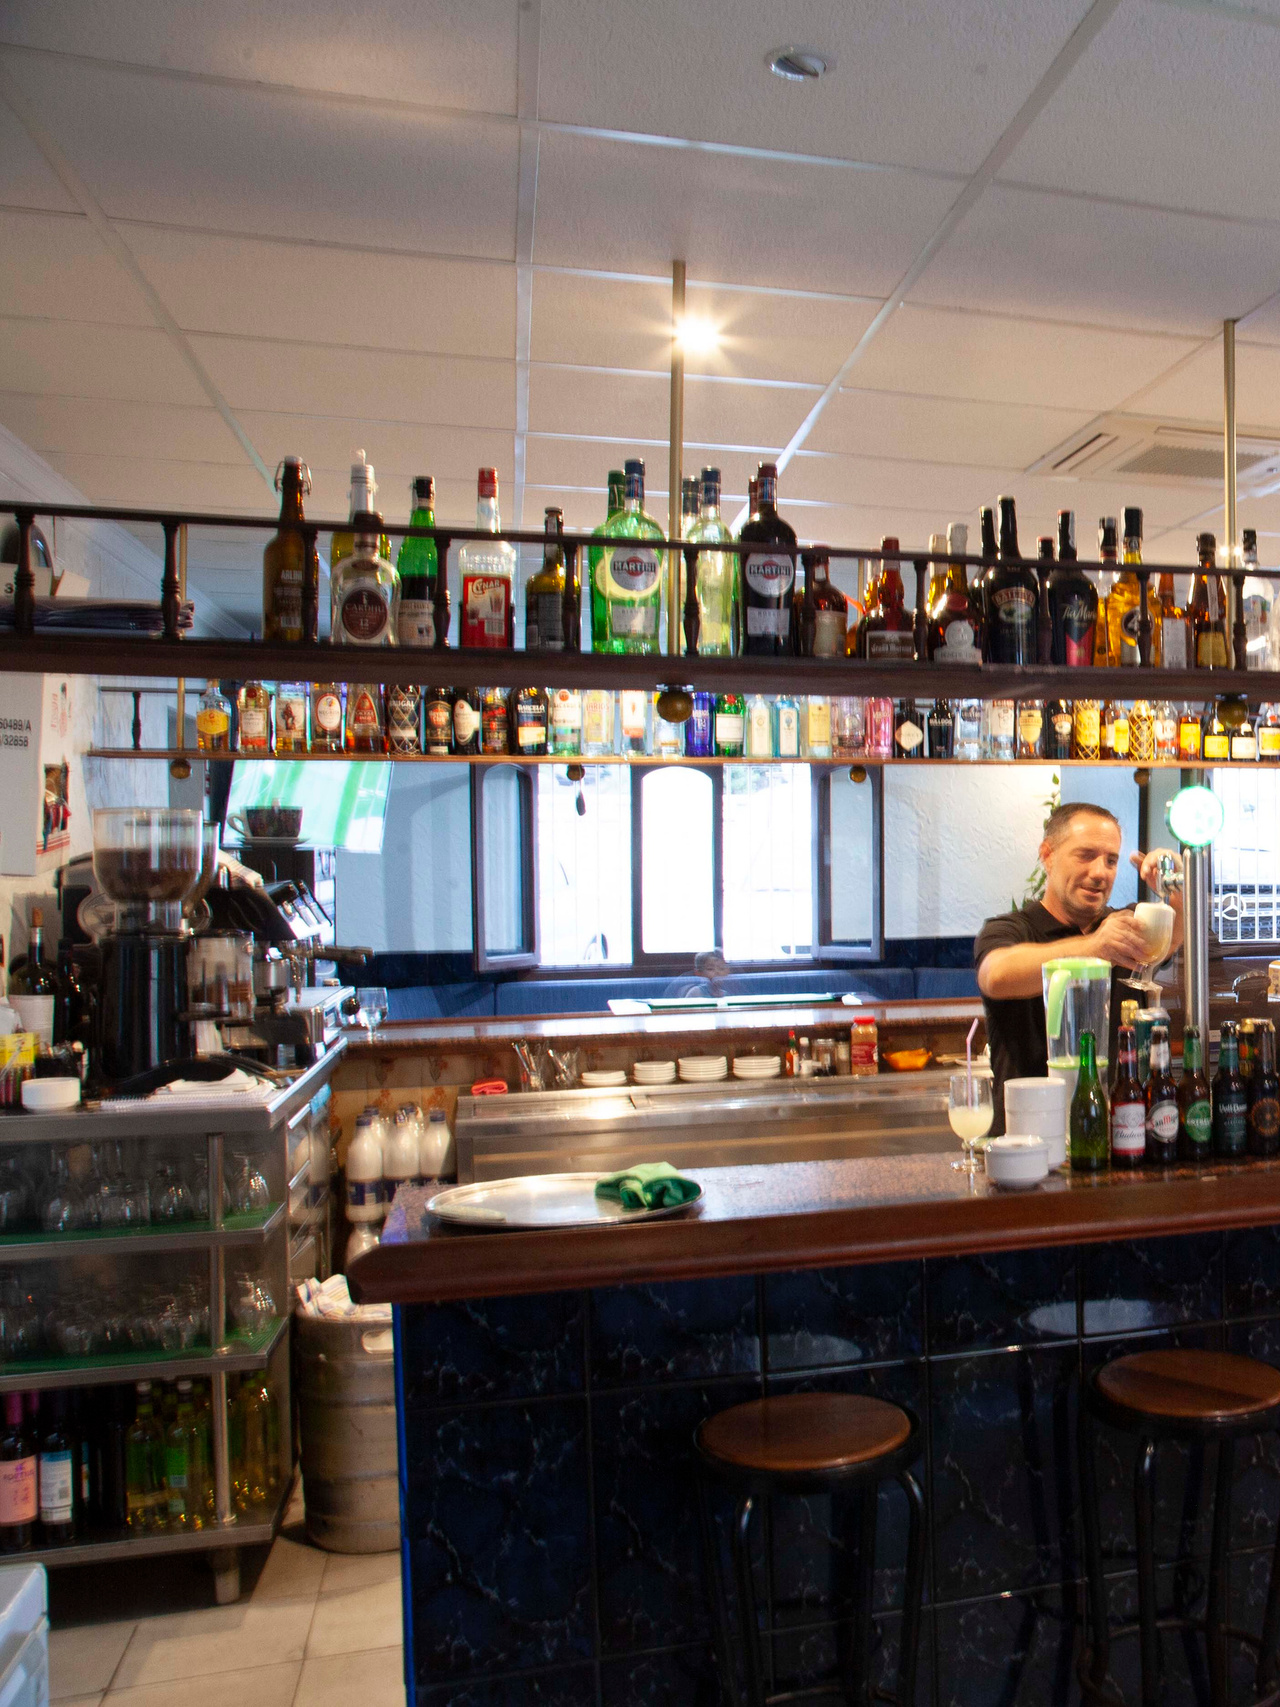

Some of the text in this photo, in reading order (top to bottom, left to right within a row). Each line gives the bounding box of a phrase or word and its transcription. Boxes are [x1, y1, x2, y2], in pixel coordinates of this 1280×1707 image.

[613, 559, 656, 573] MARTINI
[749, 563, 790, 576] MARTINI
[471, 577, 501, 598] CYNAR
[345, 603, 387, 613] CARDHU
[517, 704, 546, 714] BARCELÓ
